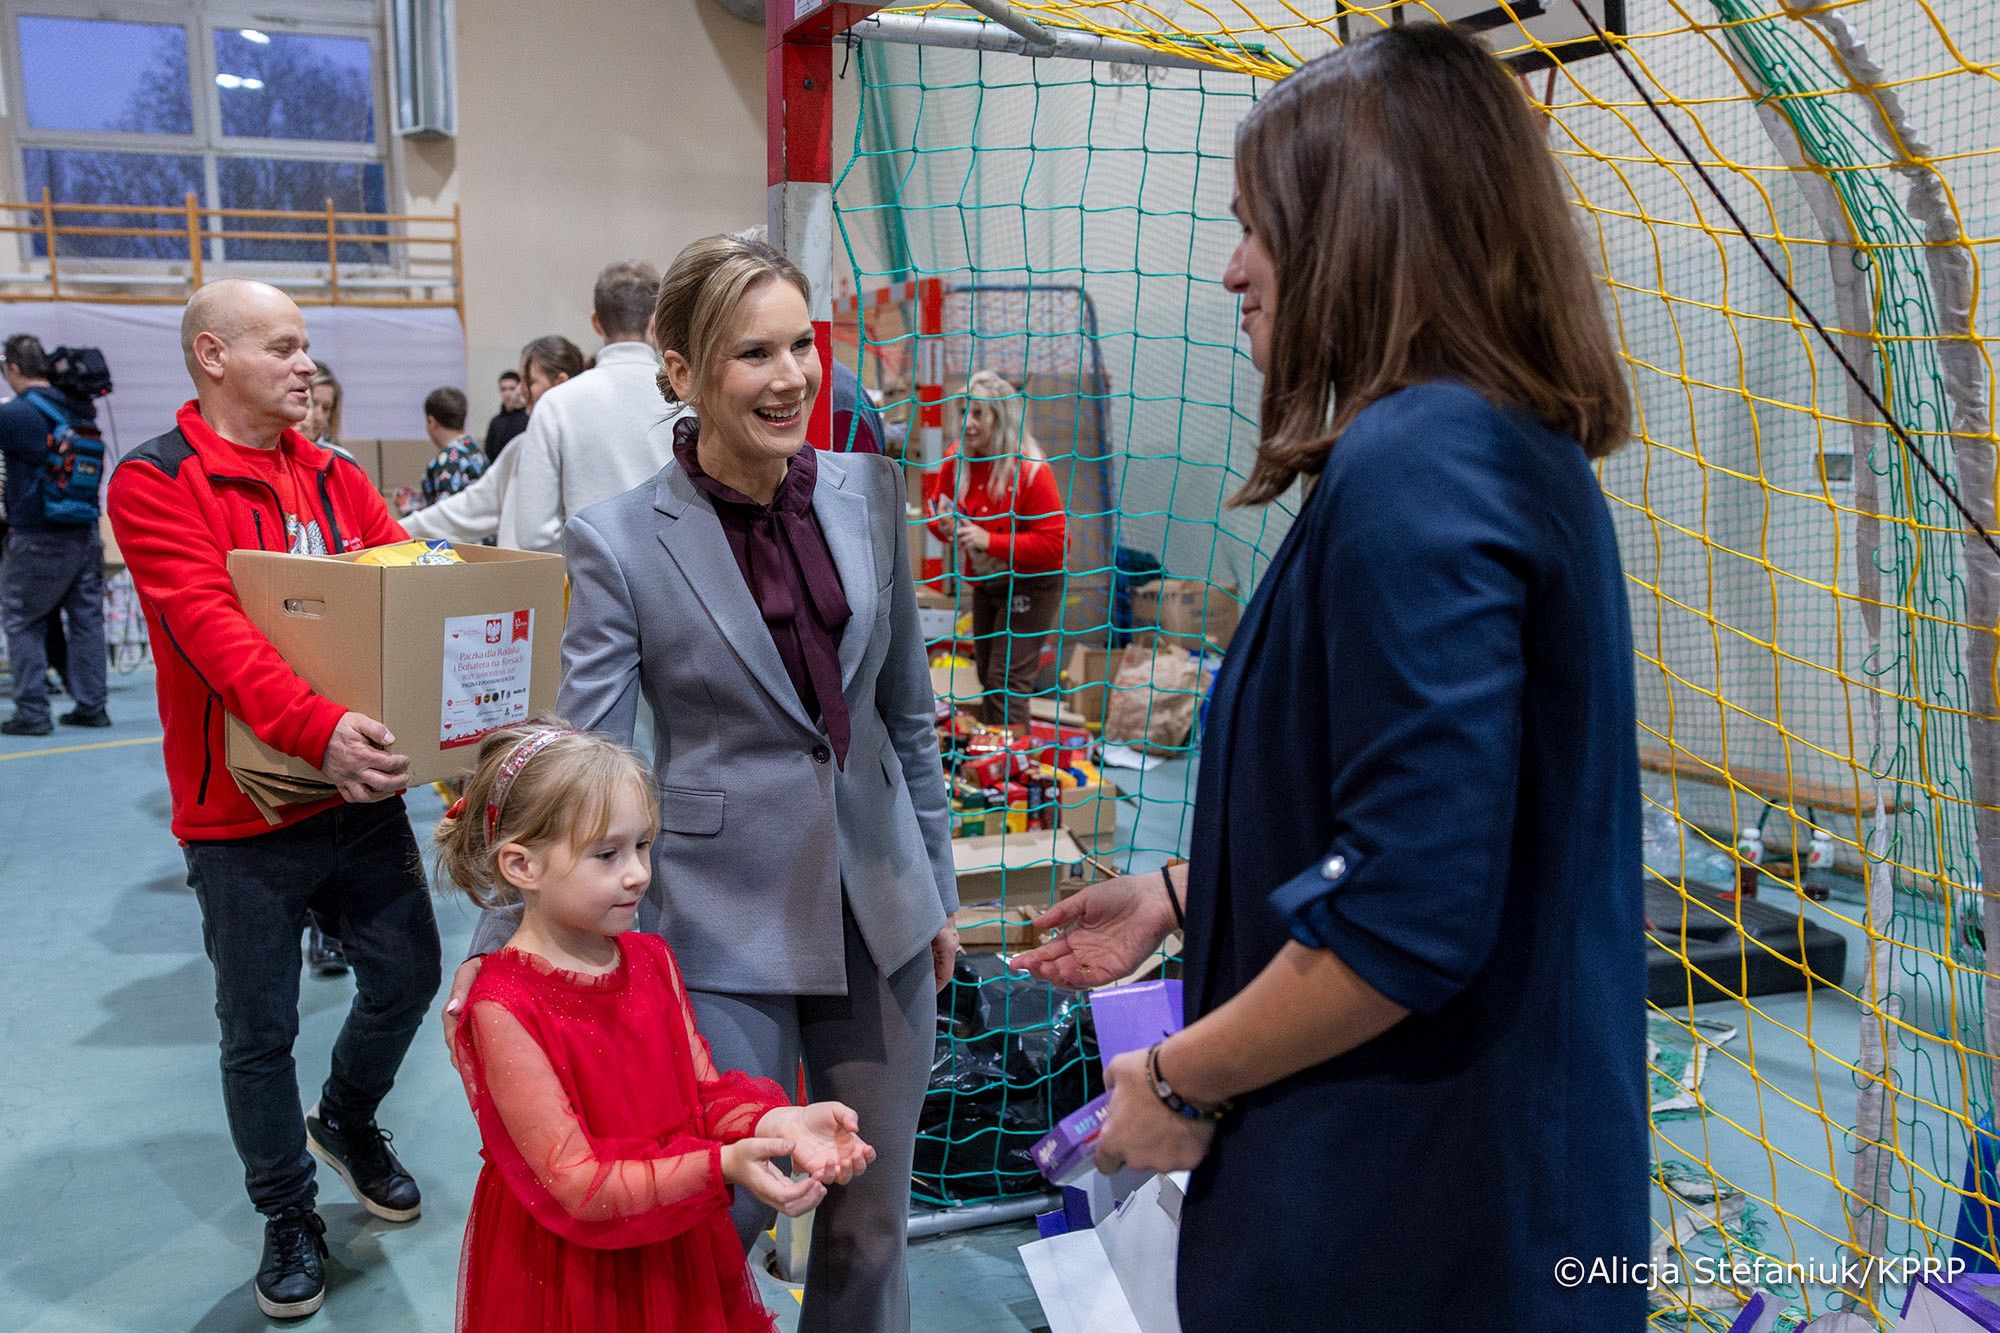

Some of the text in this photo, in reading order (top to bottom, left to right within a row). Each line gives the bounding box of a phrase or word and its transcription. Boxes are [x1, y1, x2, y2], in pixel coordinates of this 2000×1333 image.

[459, 647, 520, 661] Paczka dla Rodaka
[458, 662, 490, 672] Bohatera
[502, 656, 524, 665] Kresach
